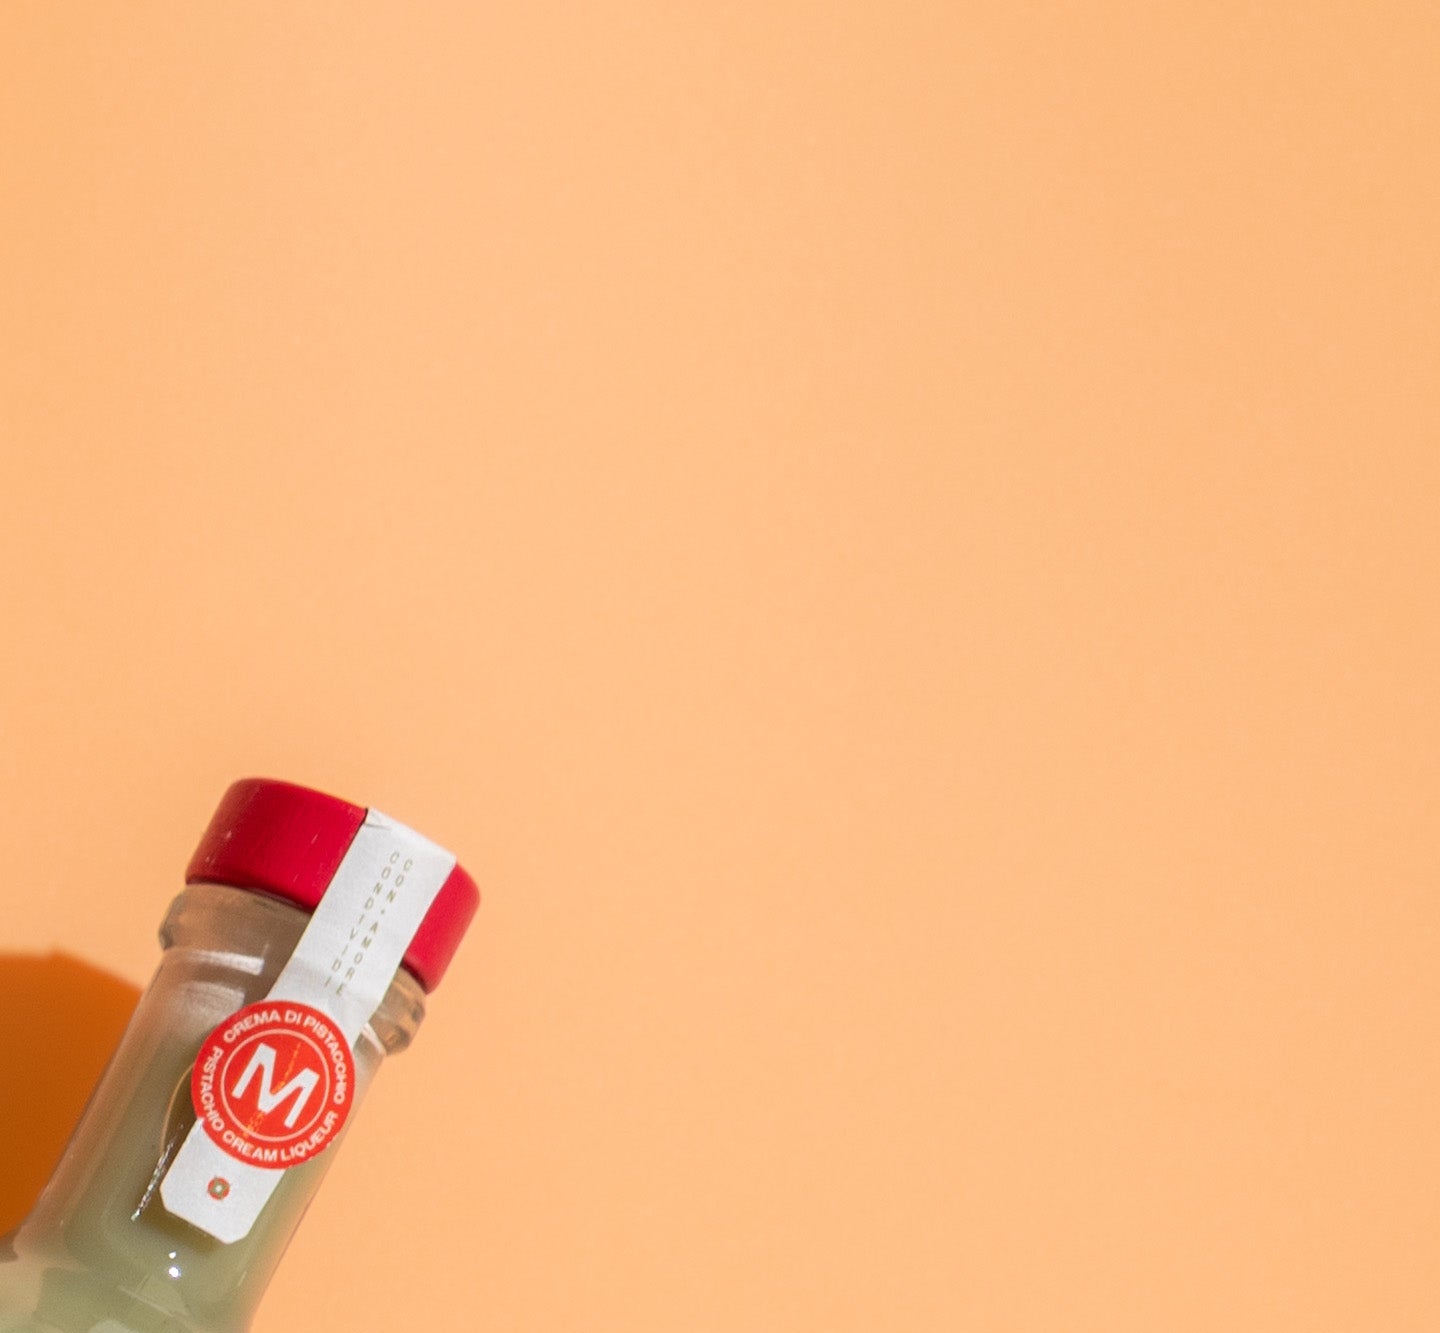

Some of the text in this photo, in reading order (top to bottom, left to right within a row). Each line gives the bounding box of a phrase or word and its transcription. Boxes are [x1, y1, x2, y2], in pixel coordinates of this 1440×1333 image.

[201, 1045, 339, 1162] PISTACHIO CREAM LIQUEUR
[223, 1010, 347, 1105] CREMA DI PISTACCHIO
[231, 1042, 320, 1129] M
